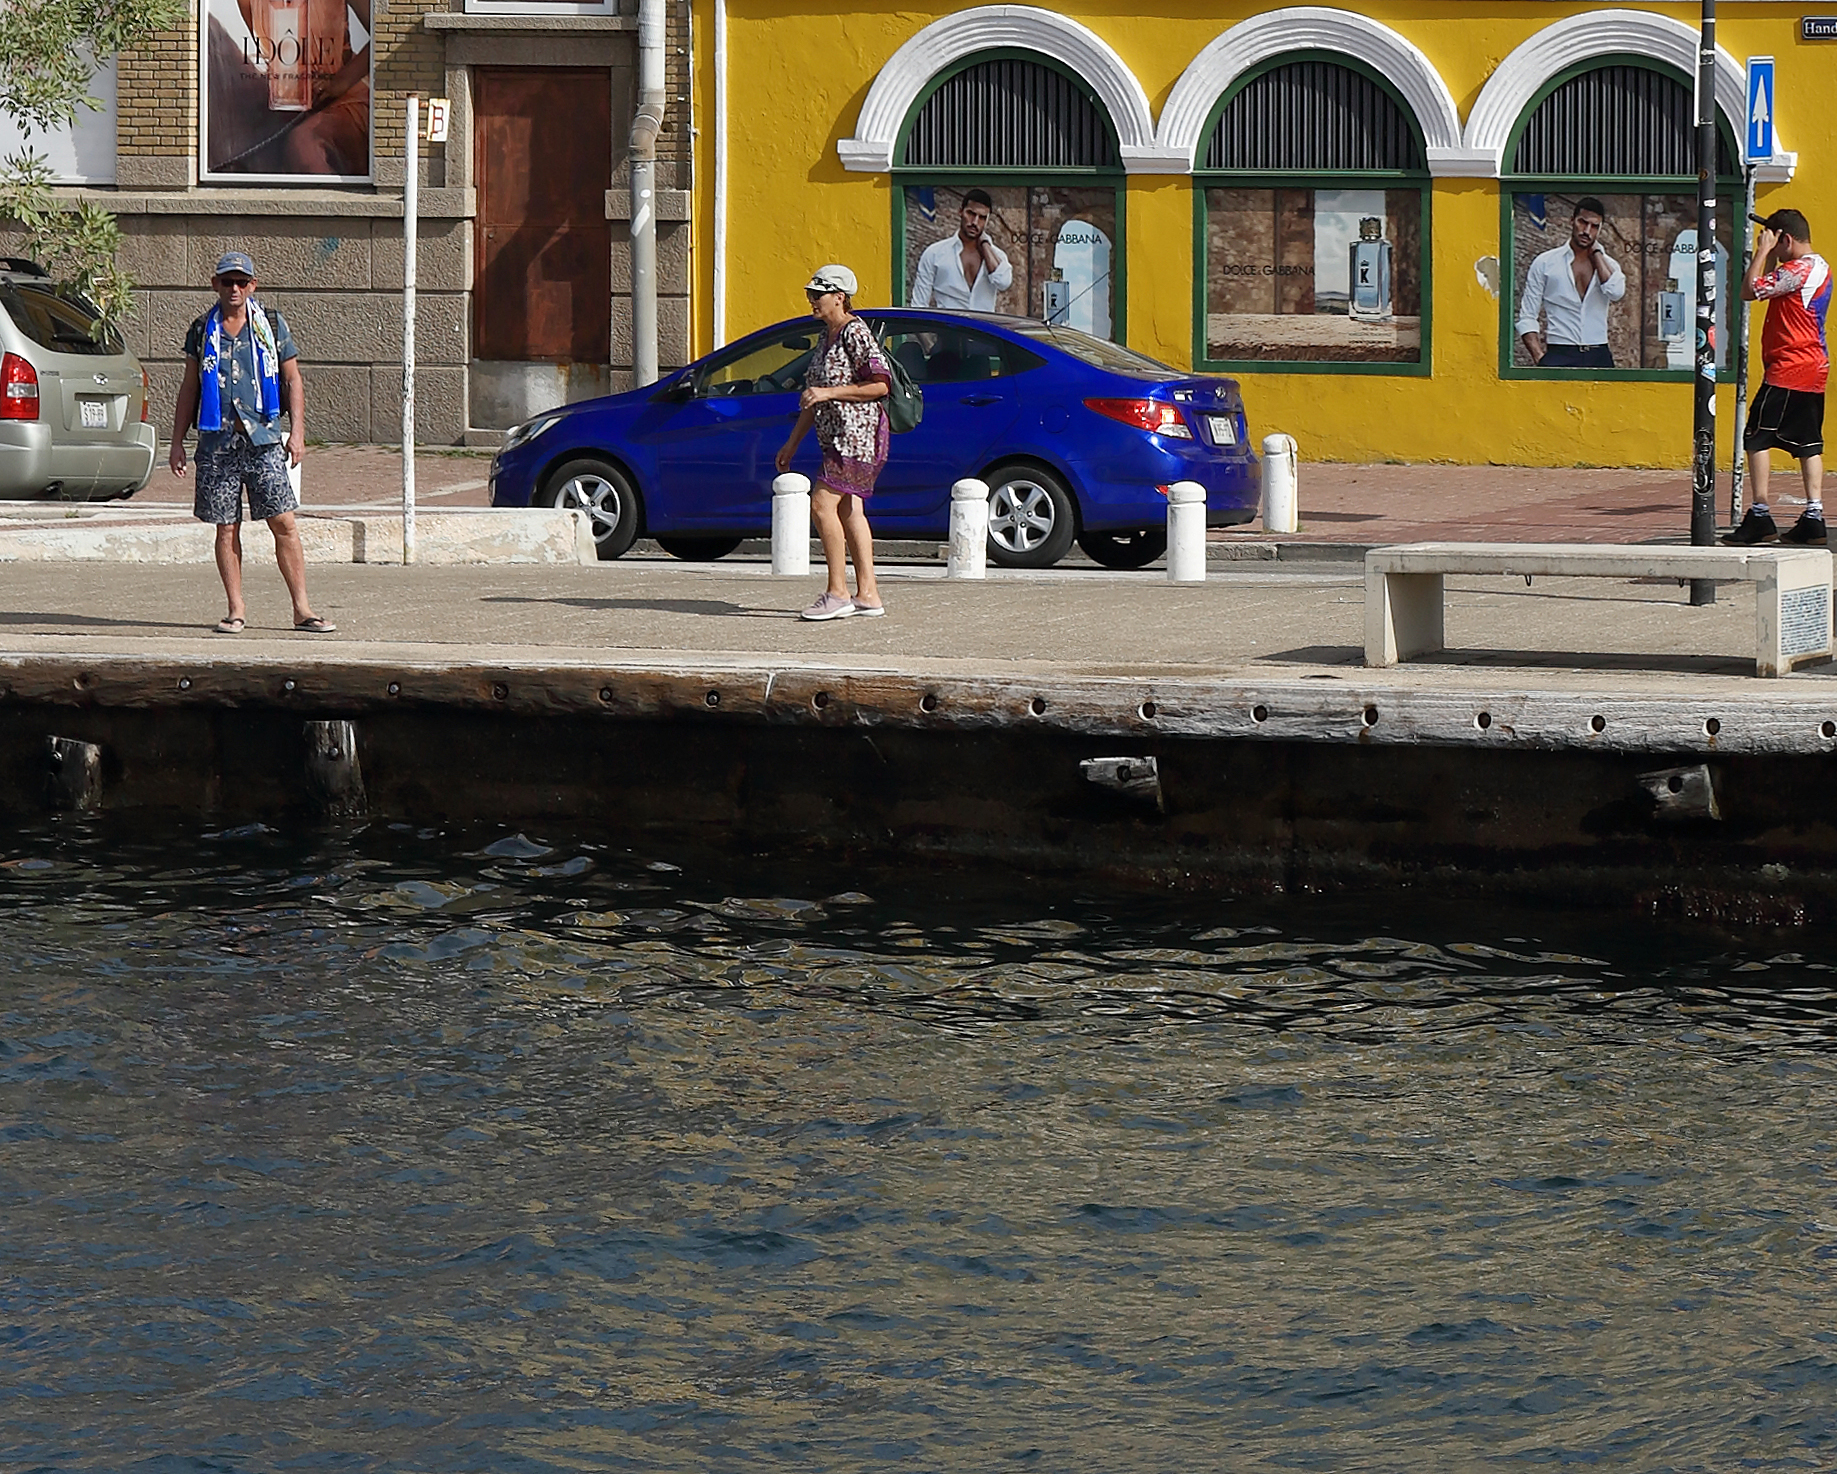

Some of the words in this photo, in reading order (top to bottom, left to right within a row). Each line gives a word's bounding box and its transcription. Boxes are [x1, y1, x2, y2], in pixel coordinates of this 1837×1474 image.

[1011, 233, 1045, 244] DOCE
[1050, 233, 1103, 244] GABBANA
[1625, 241, 1658, 253] DOCE
[1223, 264, 1257, 276] DOLCE
[1360, 268, 1369, 284] K
